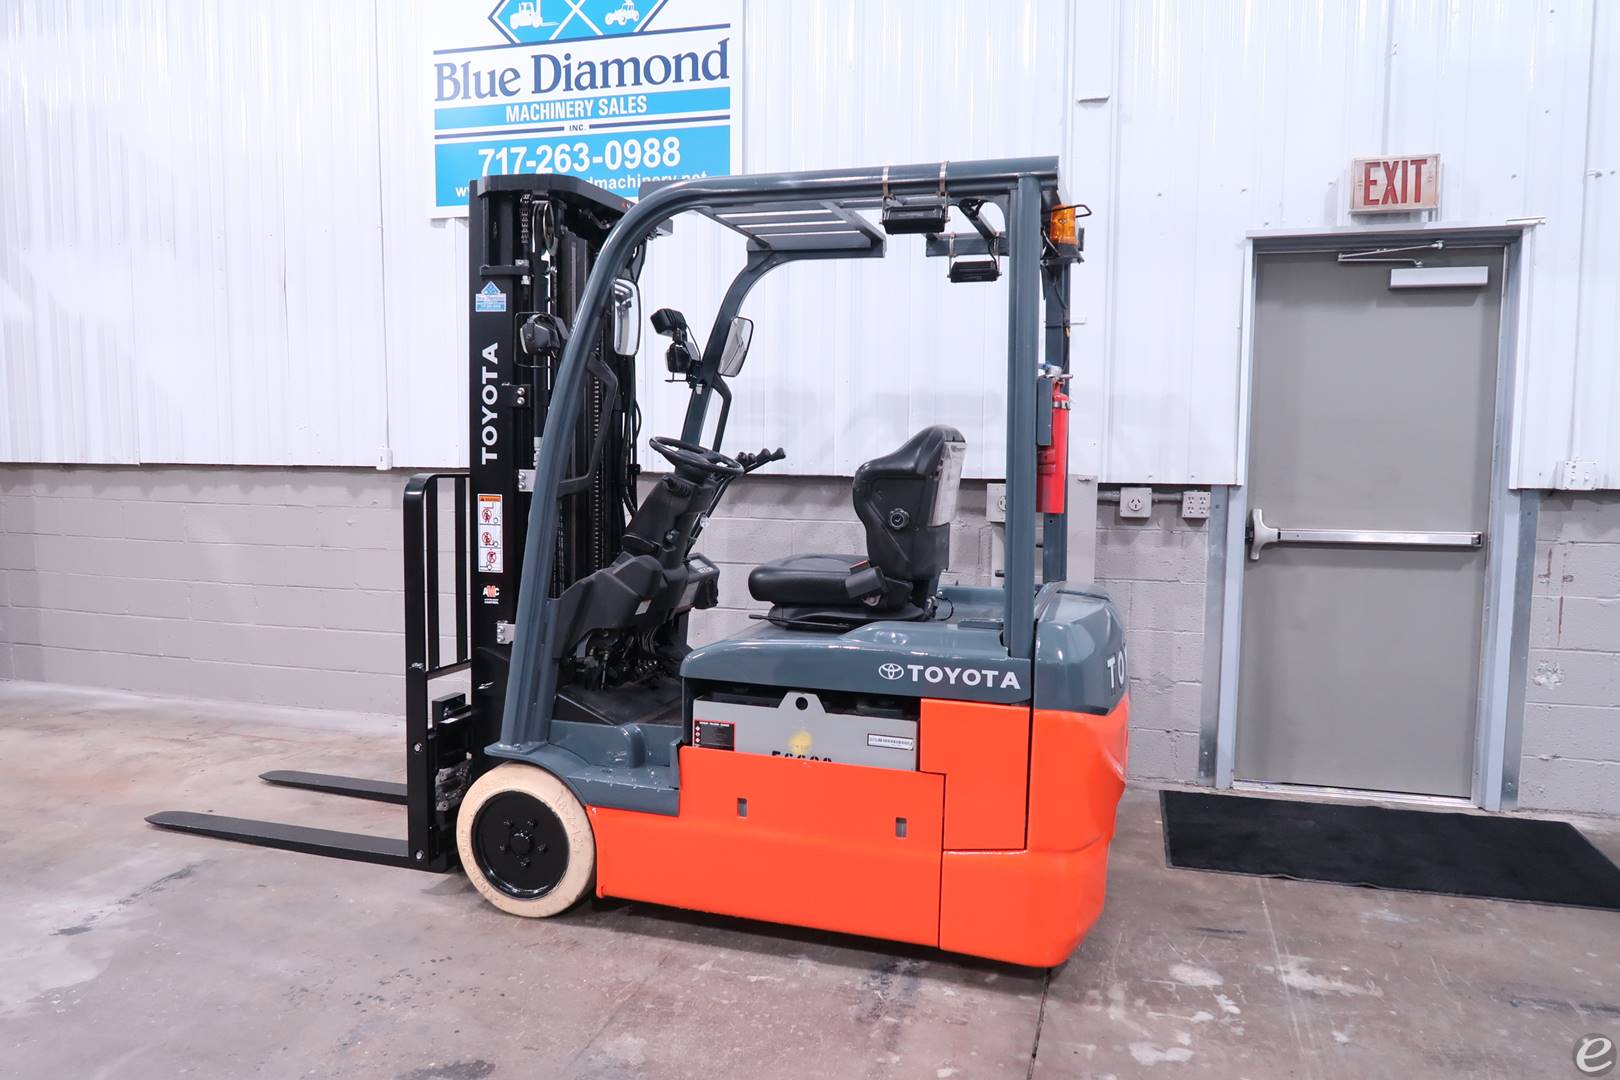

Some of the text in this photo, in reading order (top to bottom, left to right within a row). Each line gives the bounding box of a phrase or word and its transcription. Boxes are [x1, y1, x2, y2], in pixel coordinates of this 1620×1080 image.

[434, 37, 730, 102] Blue Diamond
[505, 95, 648, 123] MACHINERY SALES
[568, 123, 588, 132] INC.
[478, 136, 681, 177] 717-263-0988
[1363, 159, 1427, 205] EXIT
[481, 342, 498, 465] TOYOTA
[907, 664, 1021, 690] TOYOTA
